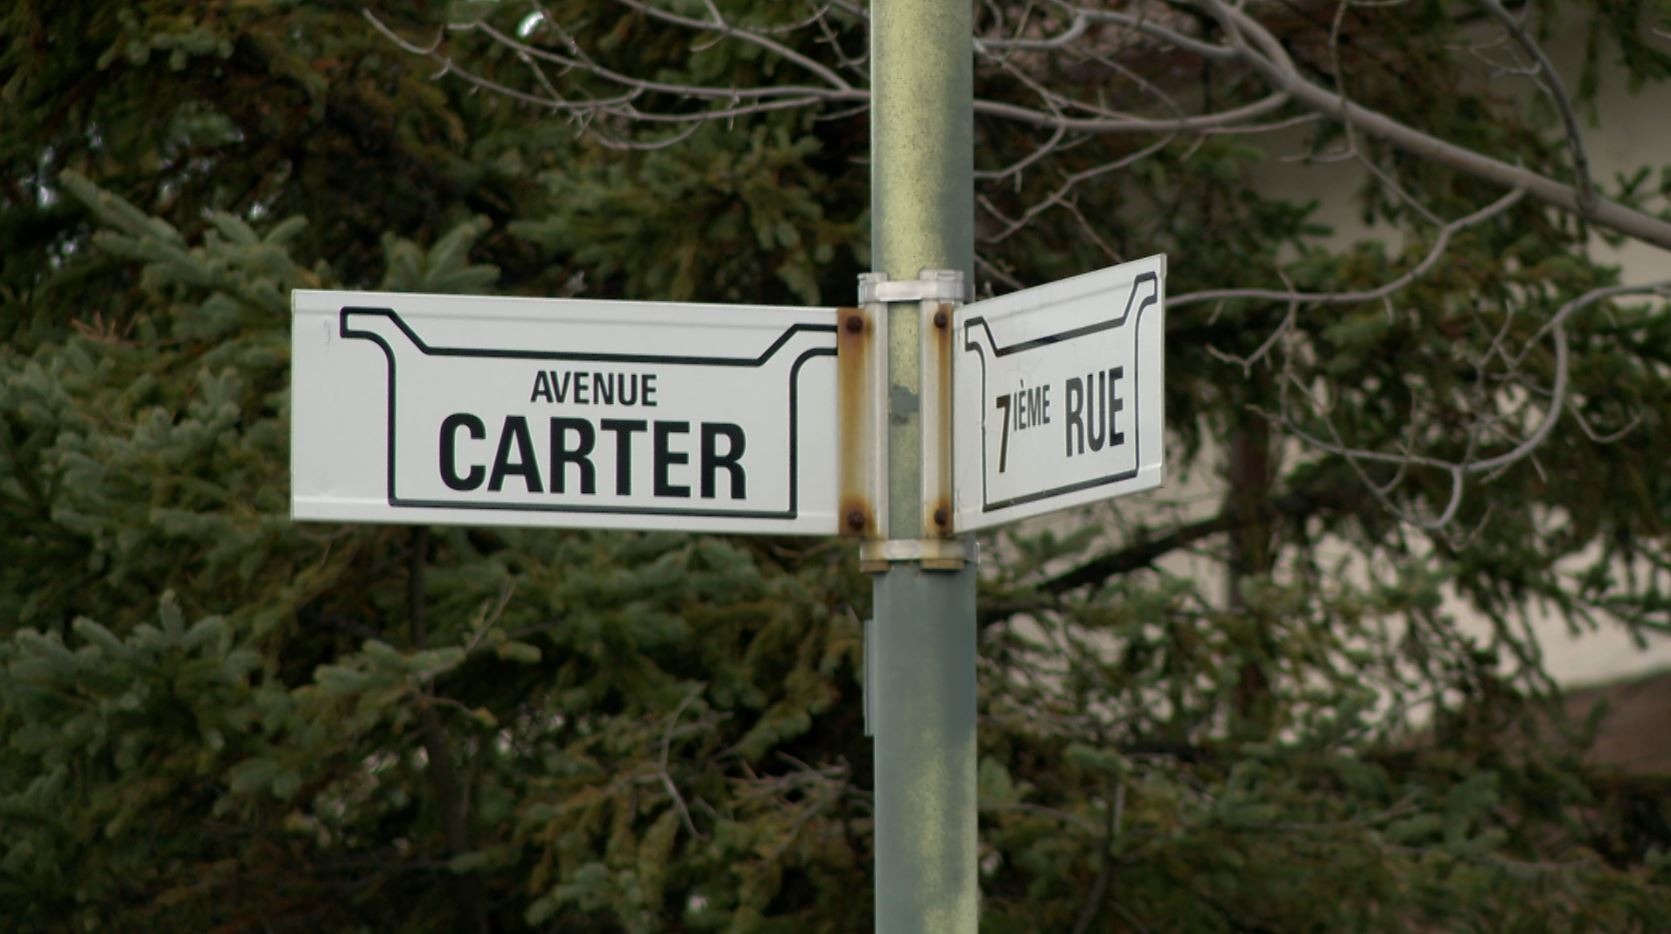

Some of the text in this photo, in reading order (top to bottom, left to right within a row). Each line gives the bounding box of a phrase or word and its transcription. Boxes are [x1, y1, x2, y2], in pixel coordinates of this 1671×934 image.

[531, 370, 658, 407] AVENUE
[1065, 366, 1125, 457] RUE
[438, 412, 747, 500] CARTER
